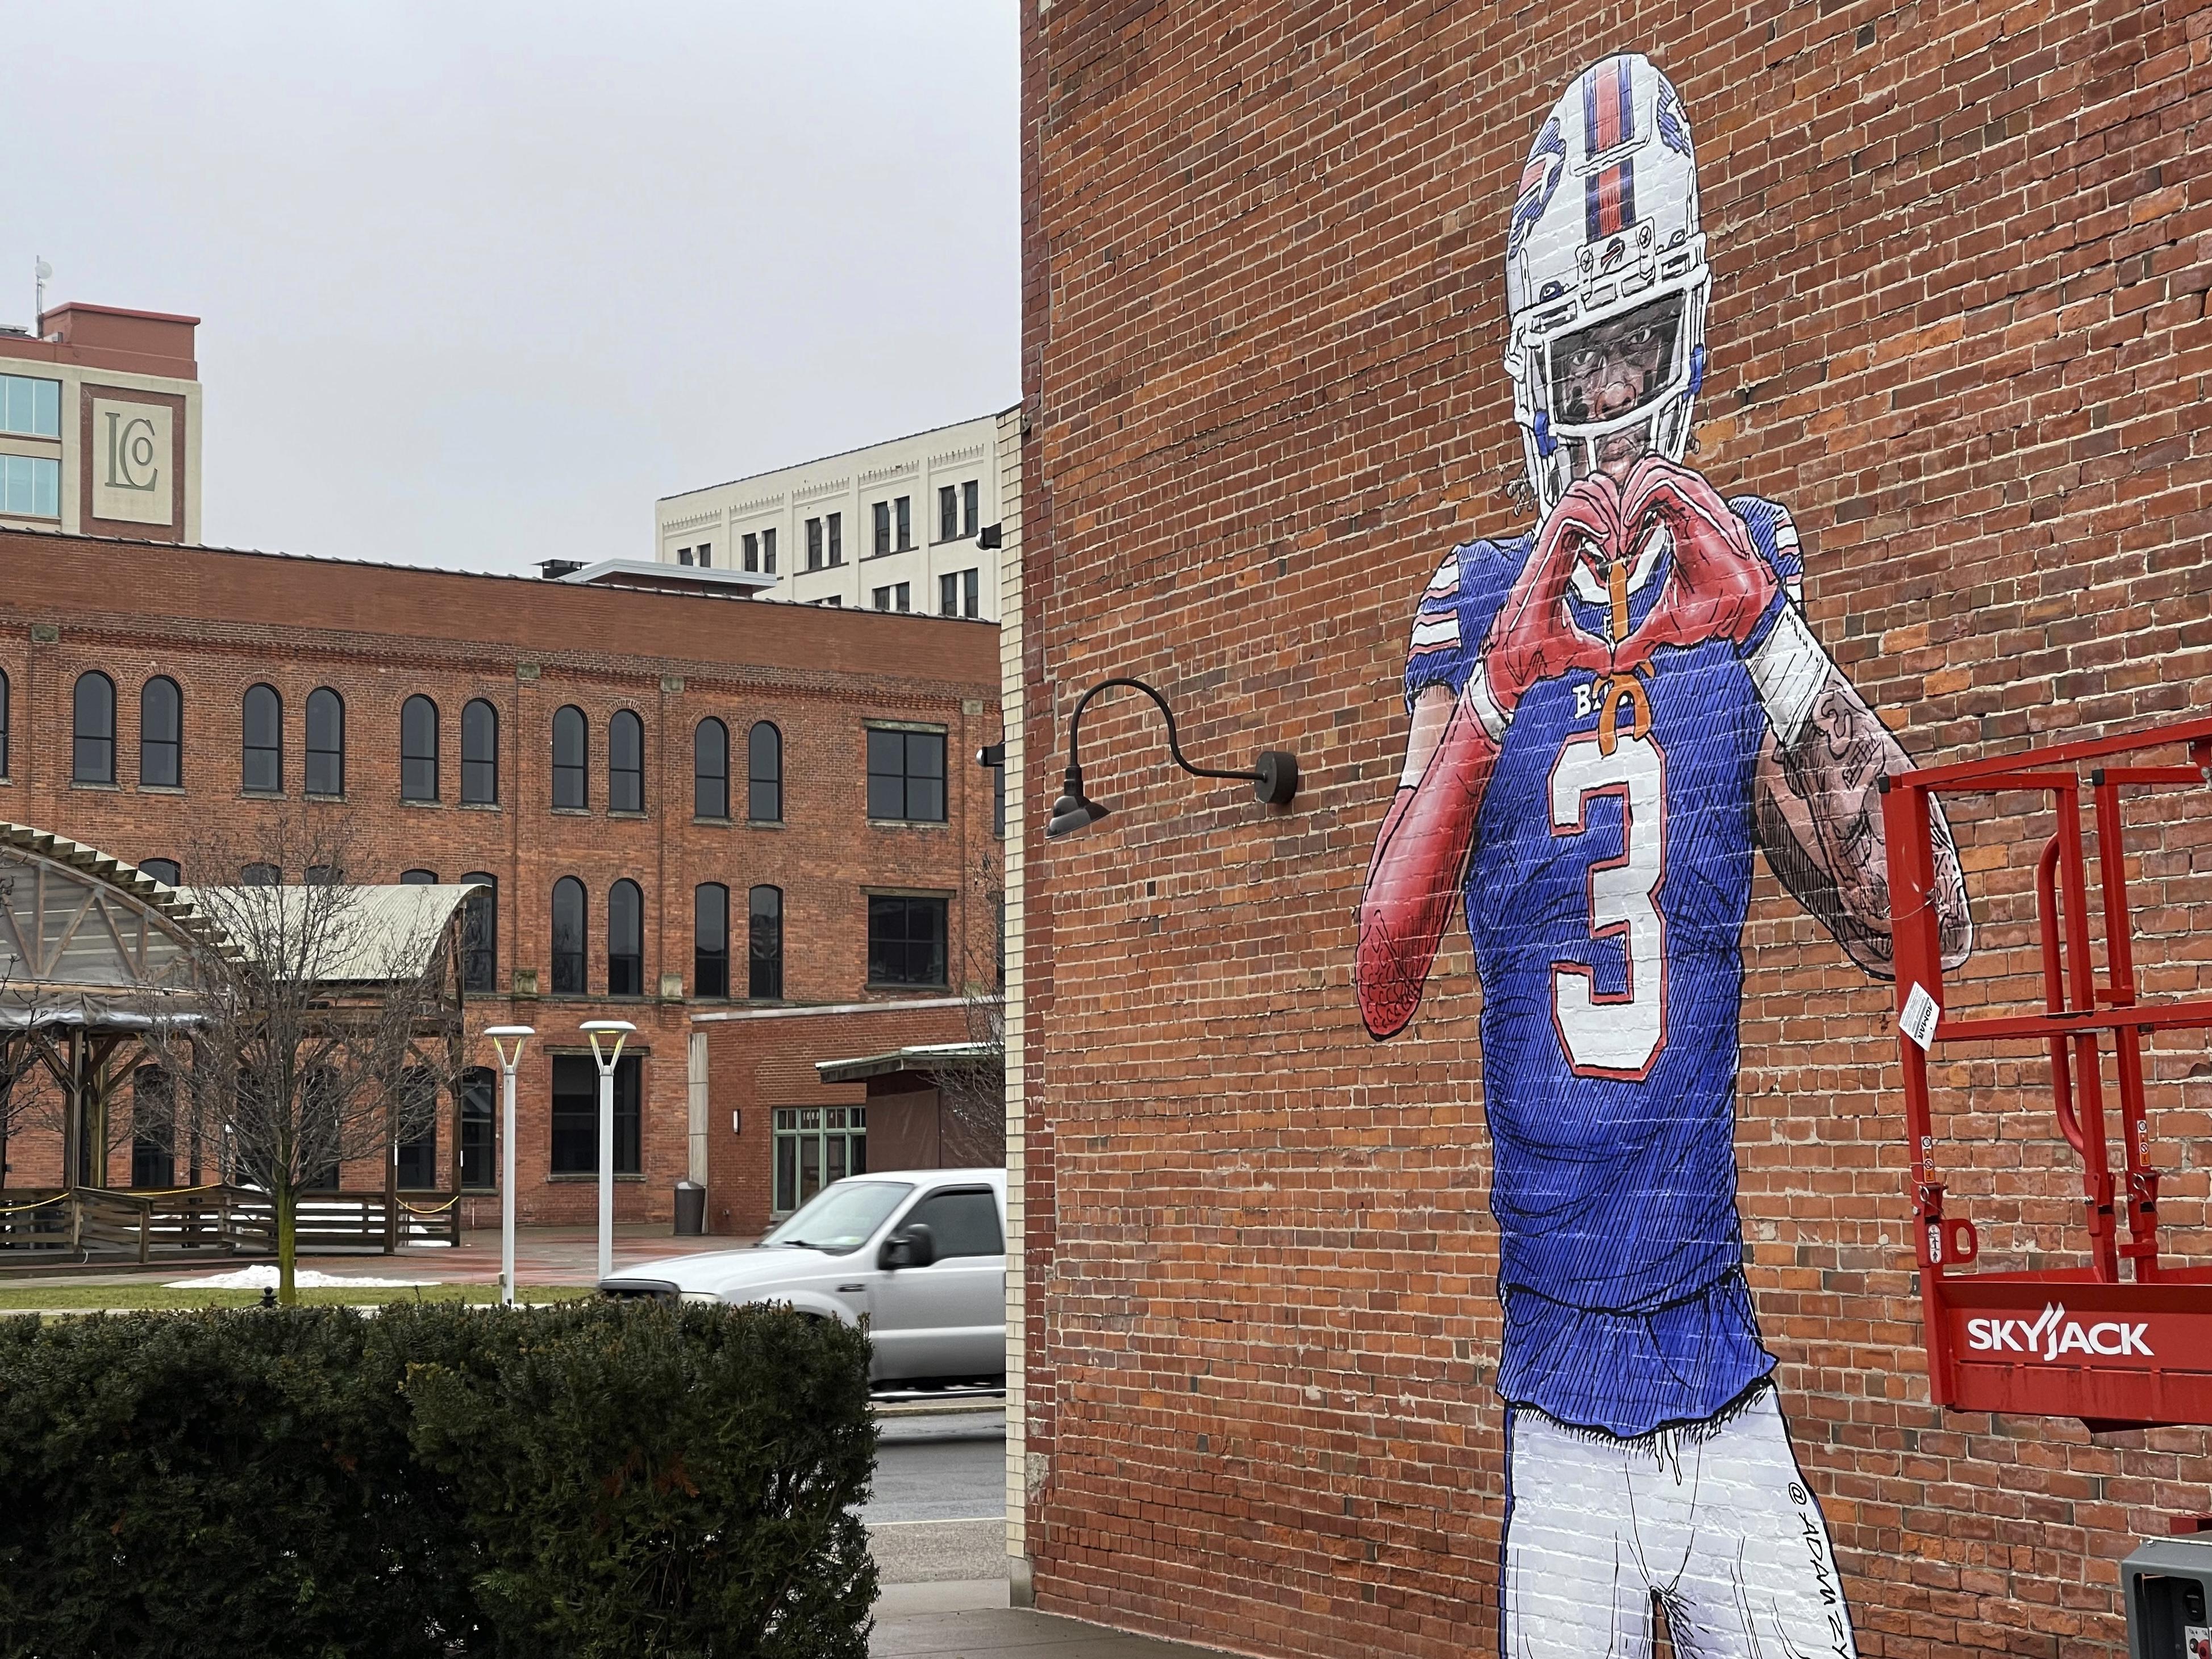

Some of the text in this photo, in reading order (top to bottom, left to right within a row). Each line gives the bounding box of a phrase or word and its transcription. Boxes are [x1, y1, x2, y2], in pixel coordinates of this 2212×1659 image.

[1547, 726, 1668, 1083] 3
[1917, 1002, 1932, 1039] ADMAR
[1967, 1302, 2155, 1361] SKYJACK
